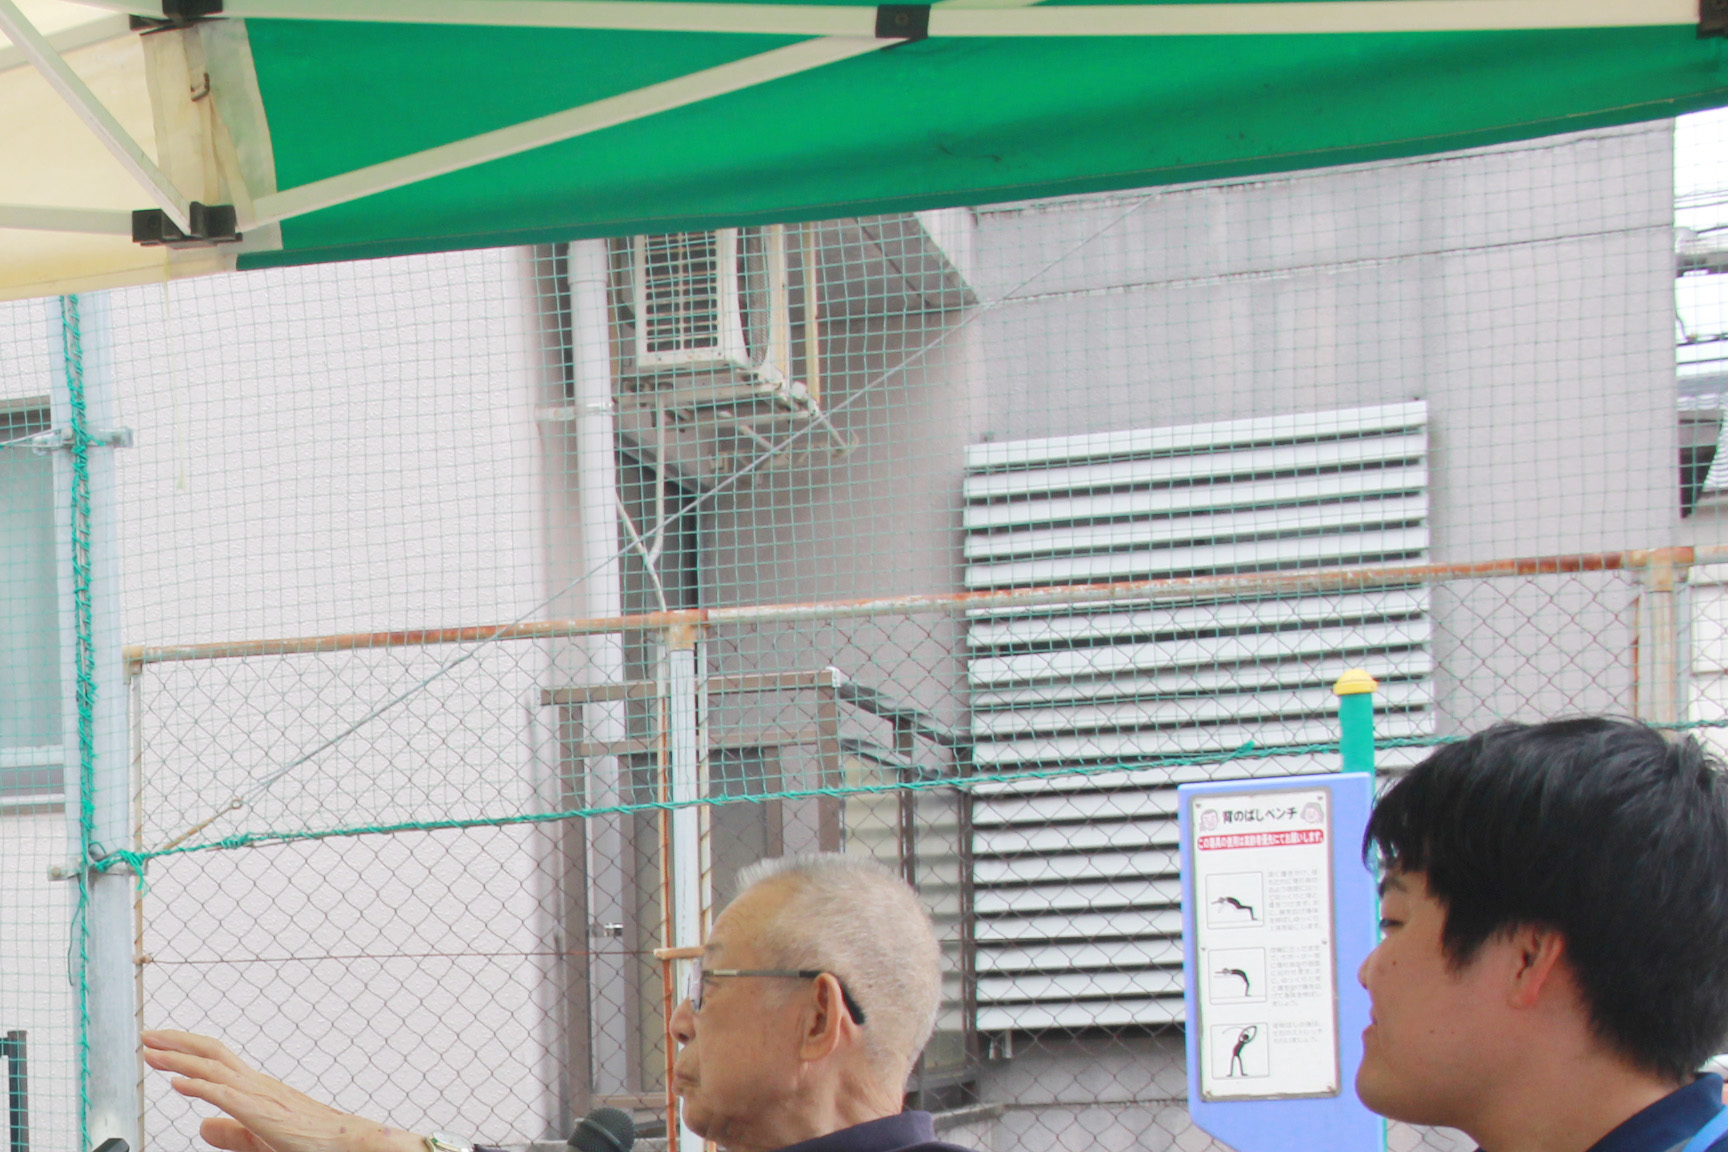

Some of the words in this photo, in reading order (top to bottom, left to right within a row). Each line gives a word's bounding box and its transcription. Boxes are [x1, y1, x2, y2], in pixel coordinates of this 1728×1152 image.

[1223, 807, 1297, 824] 背のばしベンチ
